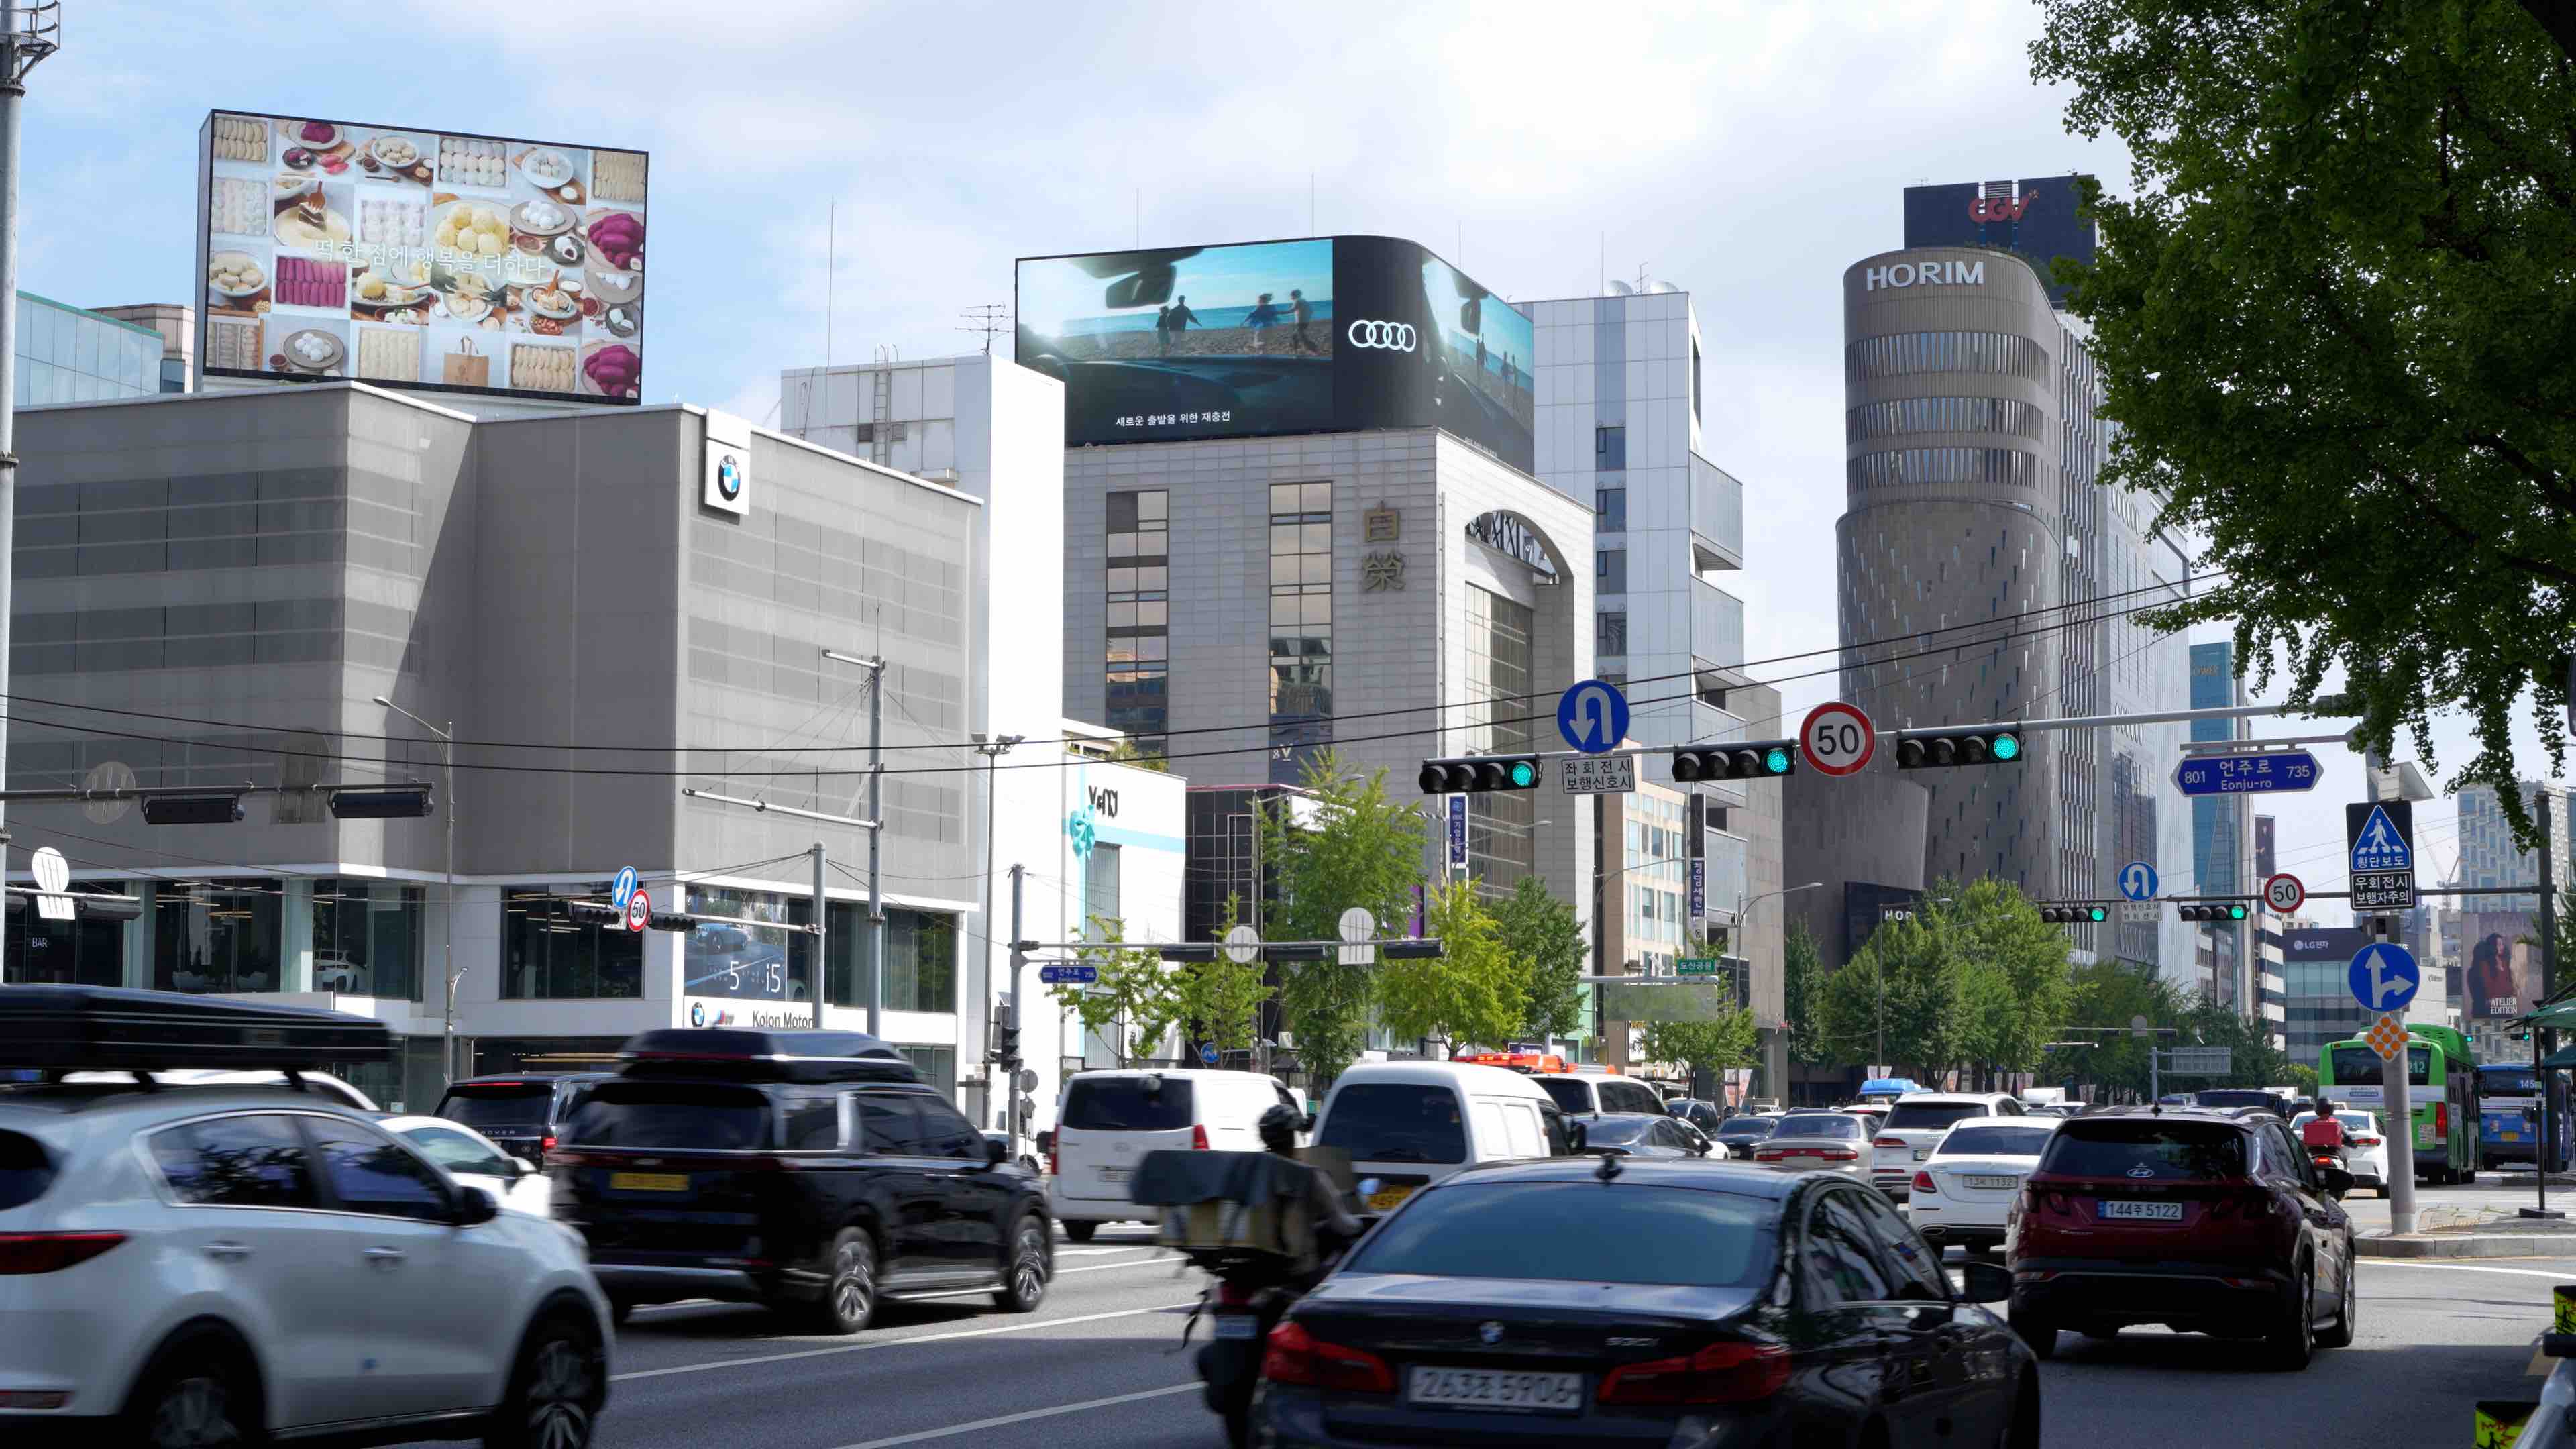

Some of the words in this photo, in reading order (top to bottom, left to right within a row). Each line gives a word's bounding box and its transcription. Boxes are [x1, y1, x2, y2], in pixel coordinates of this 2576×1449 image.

[1968, 197, 2029, 223] CGV
[314, 238, 333, 262] 떡
[343, 241, 362, 263] 한
[370, 244, 408, 267] 점에
[417, 246, 478, 274] 행복을
[484, 252, 545, 280] 더하다
[1867, 260, 1985, 291] HORIM
[1116, 415, 1145, 427] 새로운
[1147, 413, 1176, 426] 출발을
[1179, 412, 1199, 424] 위한
[1201, 410, 1231, 423] 재충전
[1817, 724, 1859, 755] 50
[1565, 759, 1631, 775] 좌회전시
[2184, 771, 2206, 784] 801
[2286, 765, 2310, 779] 735
[2219, 759, 2273, 777] 언주로
[1566, 774, 1631, 790] 보행신호시
[2221, 778, 2272, 791] Eonju-ro
[2357, 855, 2405, 869] 횡단보도
[2355, 875, 2408, 890] 우회전시
[2273, 884, 2296, 902] 50
[2355, 890, 2409, 905] 보행자주의
[632, 901, 645, 919] 50
[1884, 909, 1912, 921] HOR
[729, 961, 739, 991] 5
[766, 963, 781, 993] i5
[2490, 1006, 2518, 1015] EDITION
[2491, 998, 2518, 1006] ATELIER
[752, 1010, 781, 1028] Kolon
[783, 1012, 814, 1029] Motor
[2146, 1203, 2180, 1218] 5122
[1501, 1374, 1569, 1403] 5906
